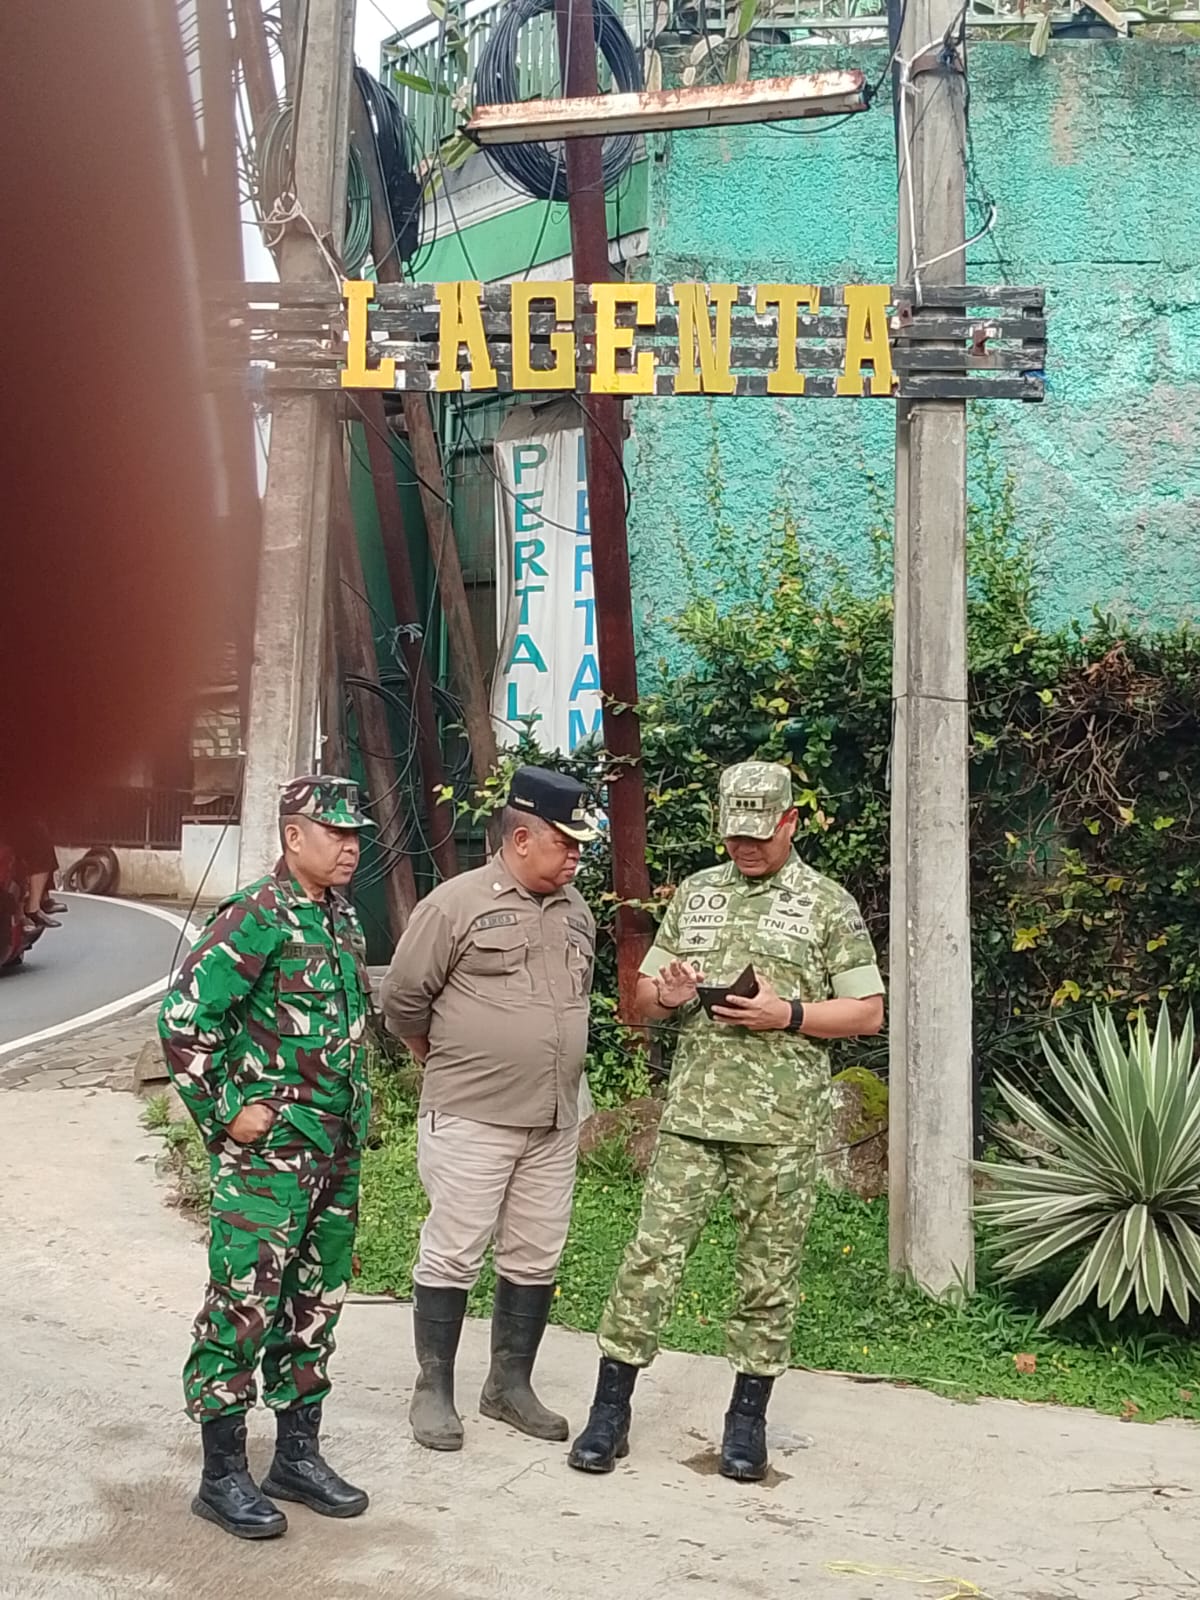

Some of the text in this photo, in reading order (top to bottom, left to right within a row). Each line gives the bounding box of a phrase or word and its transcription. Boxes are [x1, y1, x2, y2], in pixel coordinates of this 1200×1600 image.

[341, 280, 893, 394] LAGENTA
[683, 914, 724, 925] YANTO
[763, 918, 810, 936] TNI AD
